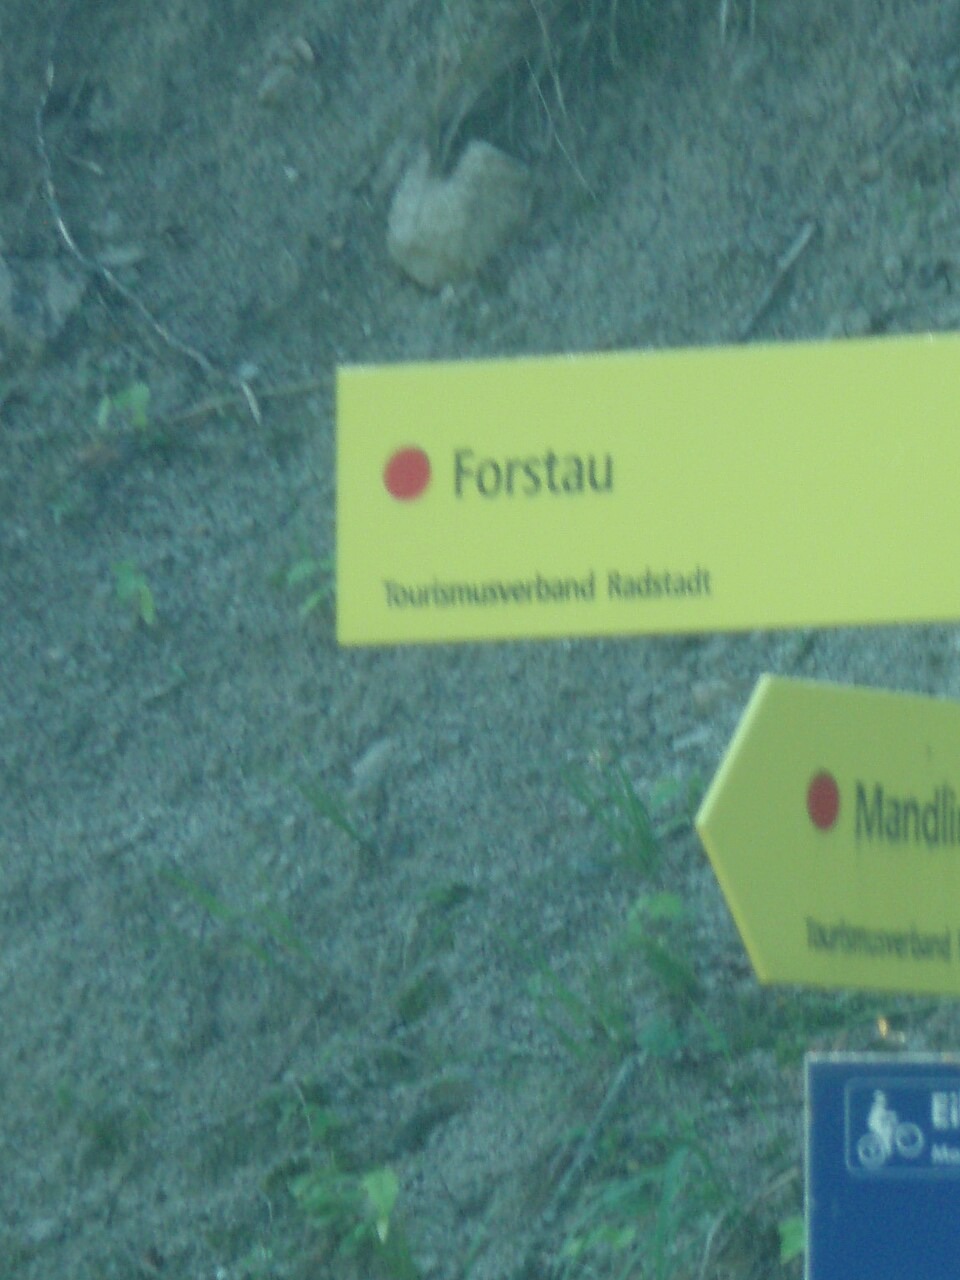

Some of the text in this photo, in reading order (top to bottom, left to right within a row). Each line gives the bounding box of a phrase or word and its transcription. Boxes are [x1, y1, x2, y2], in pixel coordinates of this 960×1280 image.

[454, 448, 615, 498] Forstau
[384, 565, 711, 608] Tourismusverband Radstadt
